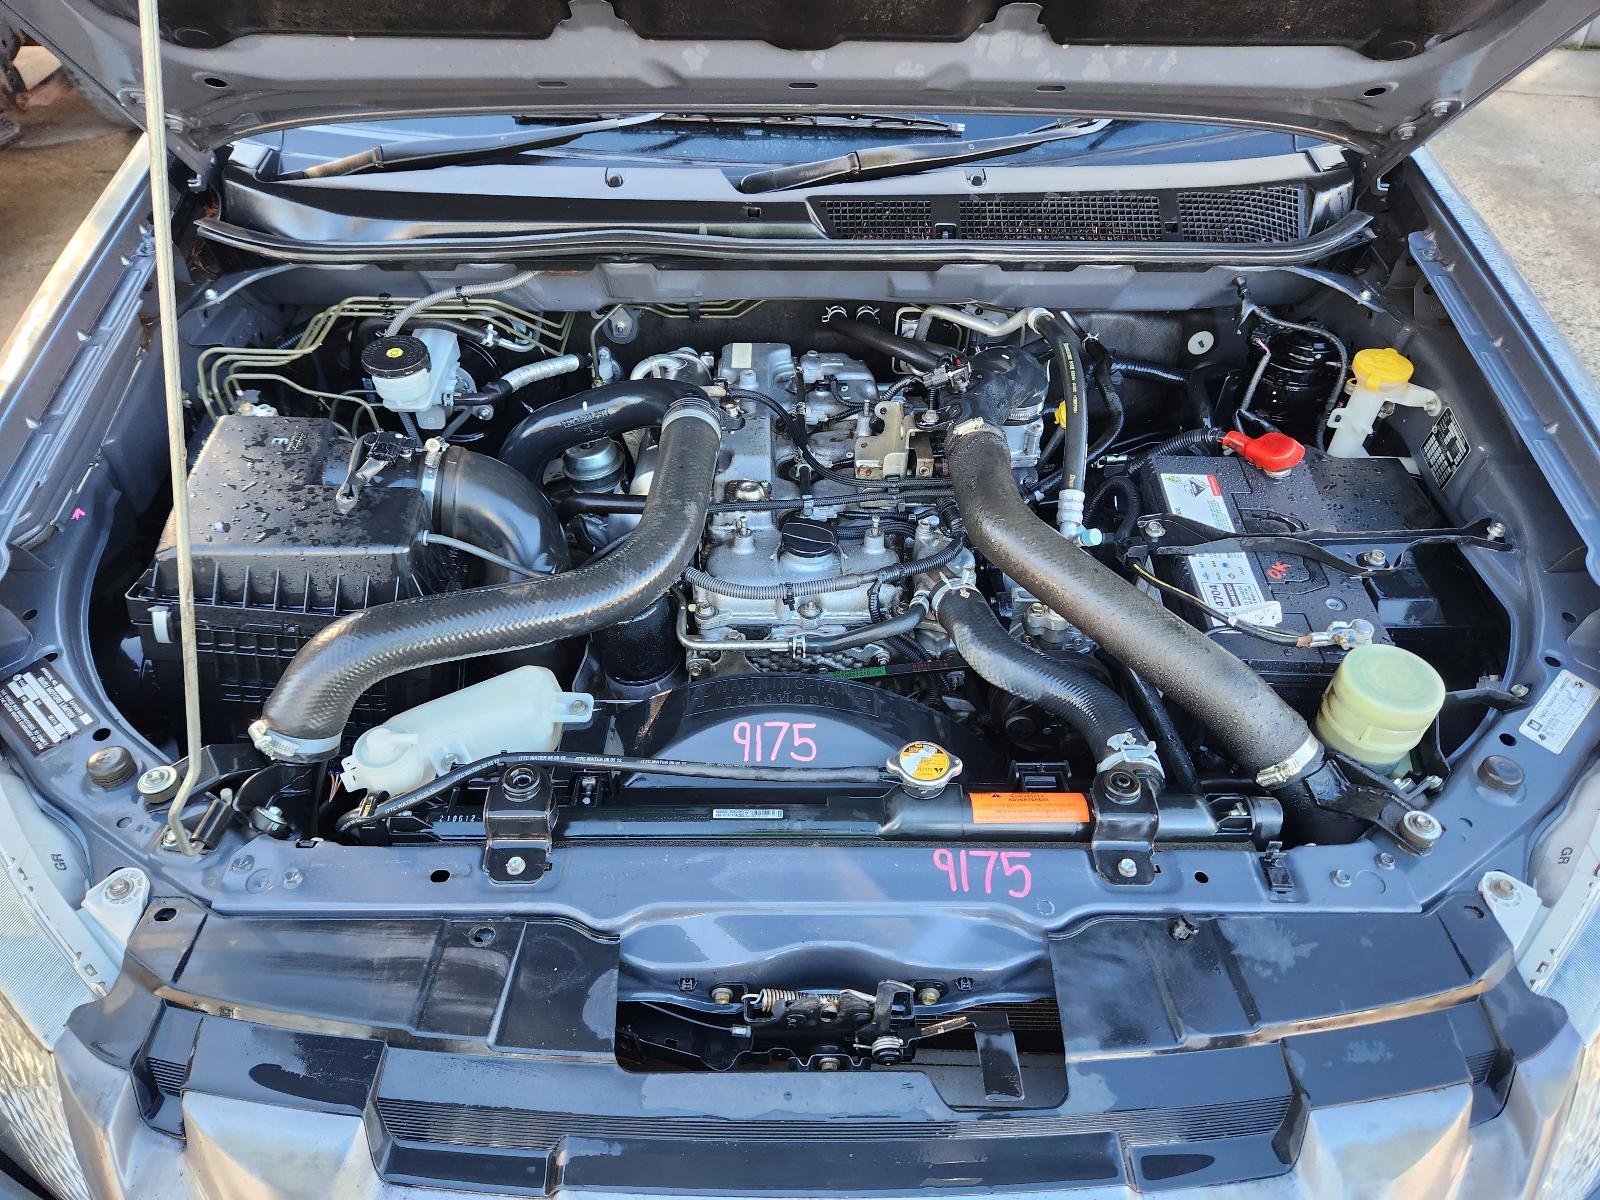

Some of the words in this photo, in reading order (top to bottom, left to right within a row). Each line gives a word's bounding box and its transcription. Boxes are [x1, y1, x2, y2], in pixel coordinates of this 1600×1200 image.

[1209, 584, 1225, 607] 4704
[46, 686, 63, 704] MOTORS
[59, 701, 75, 719] LIMITED
[733, 721, 817, 762] 9175
[463, 765, 481, 775] WATER
[396, 796, 416, 808] WATER
[933, 848, 1032, 898] 9175
